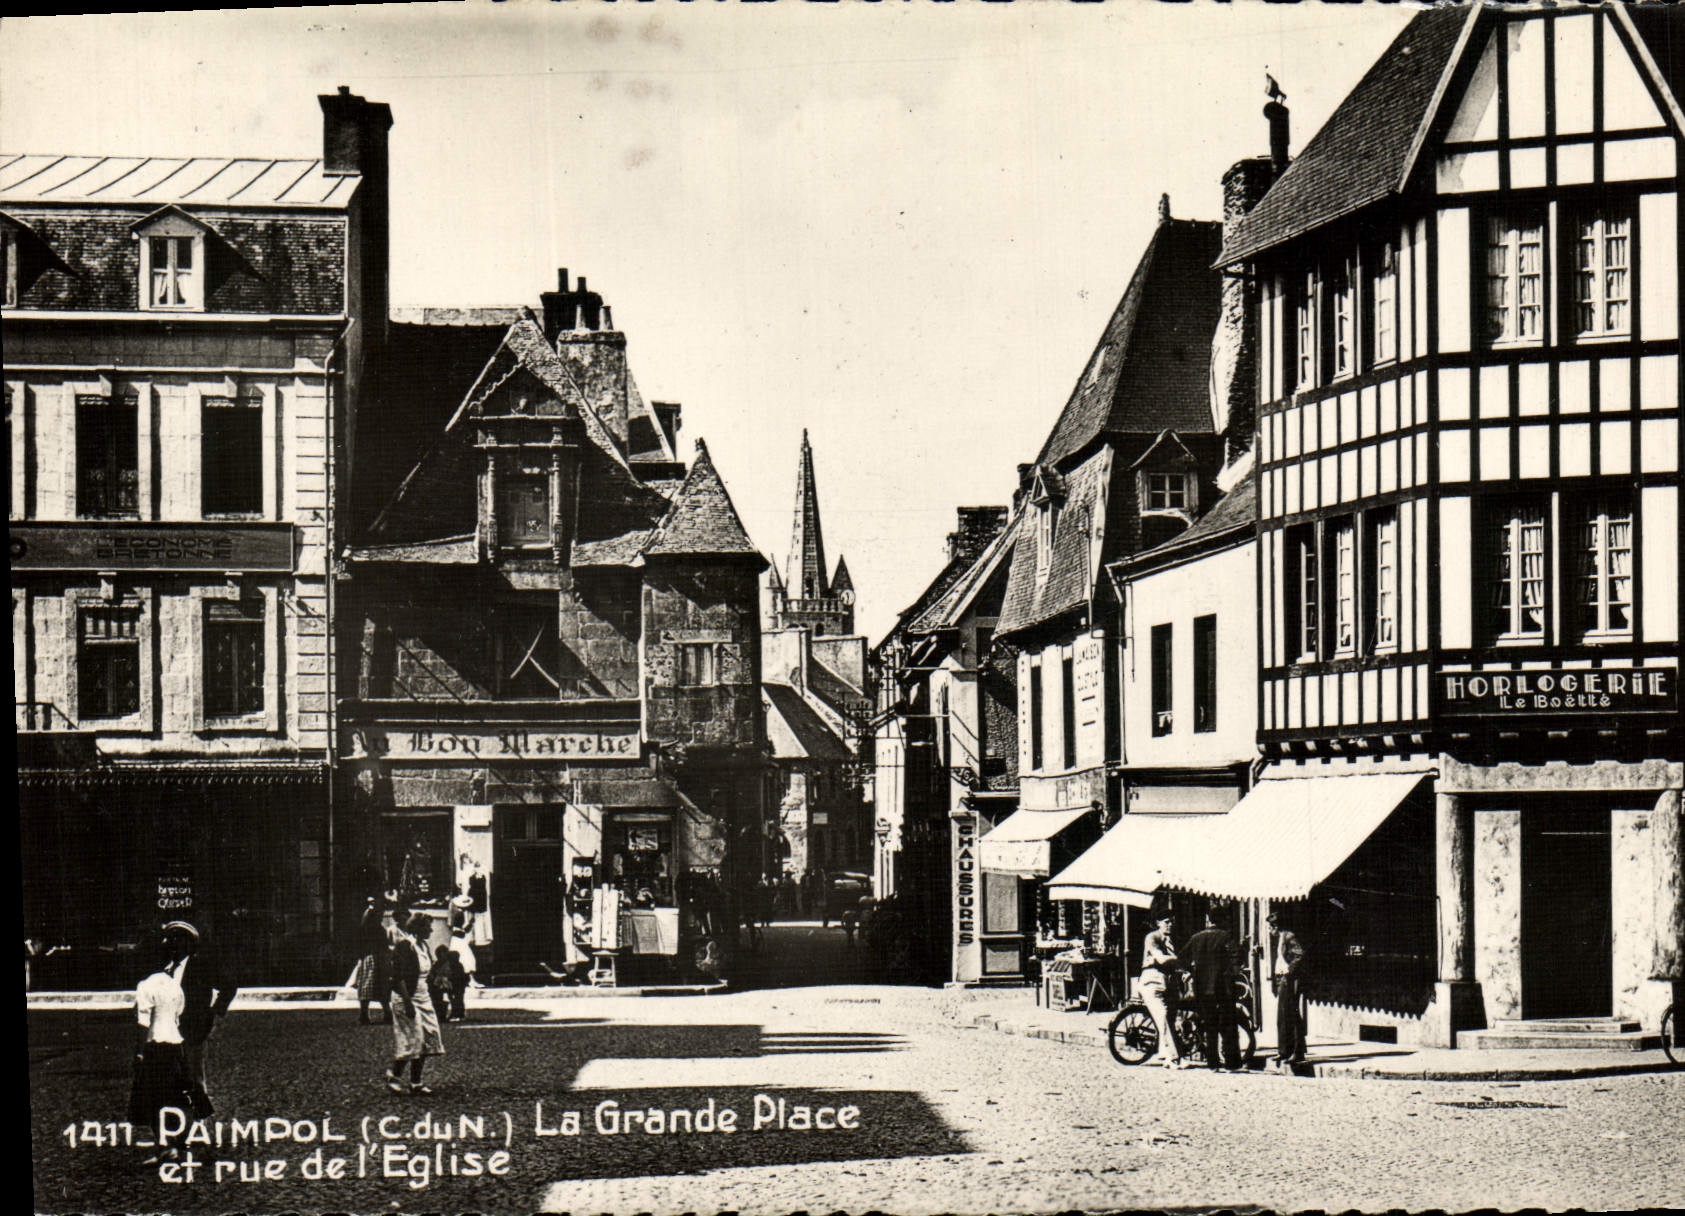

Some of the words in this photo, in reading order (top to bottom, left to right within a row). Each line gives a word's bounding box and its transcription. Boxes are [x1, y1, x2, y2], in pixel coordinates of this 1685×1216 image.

[1500, 694, 1527, 709] Le
[353, 730, 390, 752] Au
[408, 730, 480, 753] Bon
[958, 825, 973, 945] CHAUSSURES
